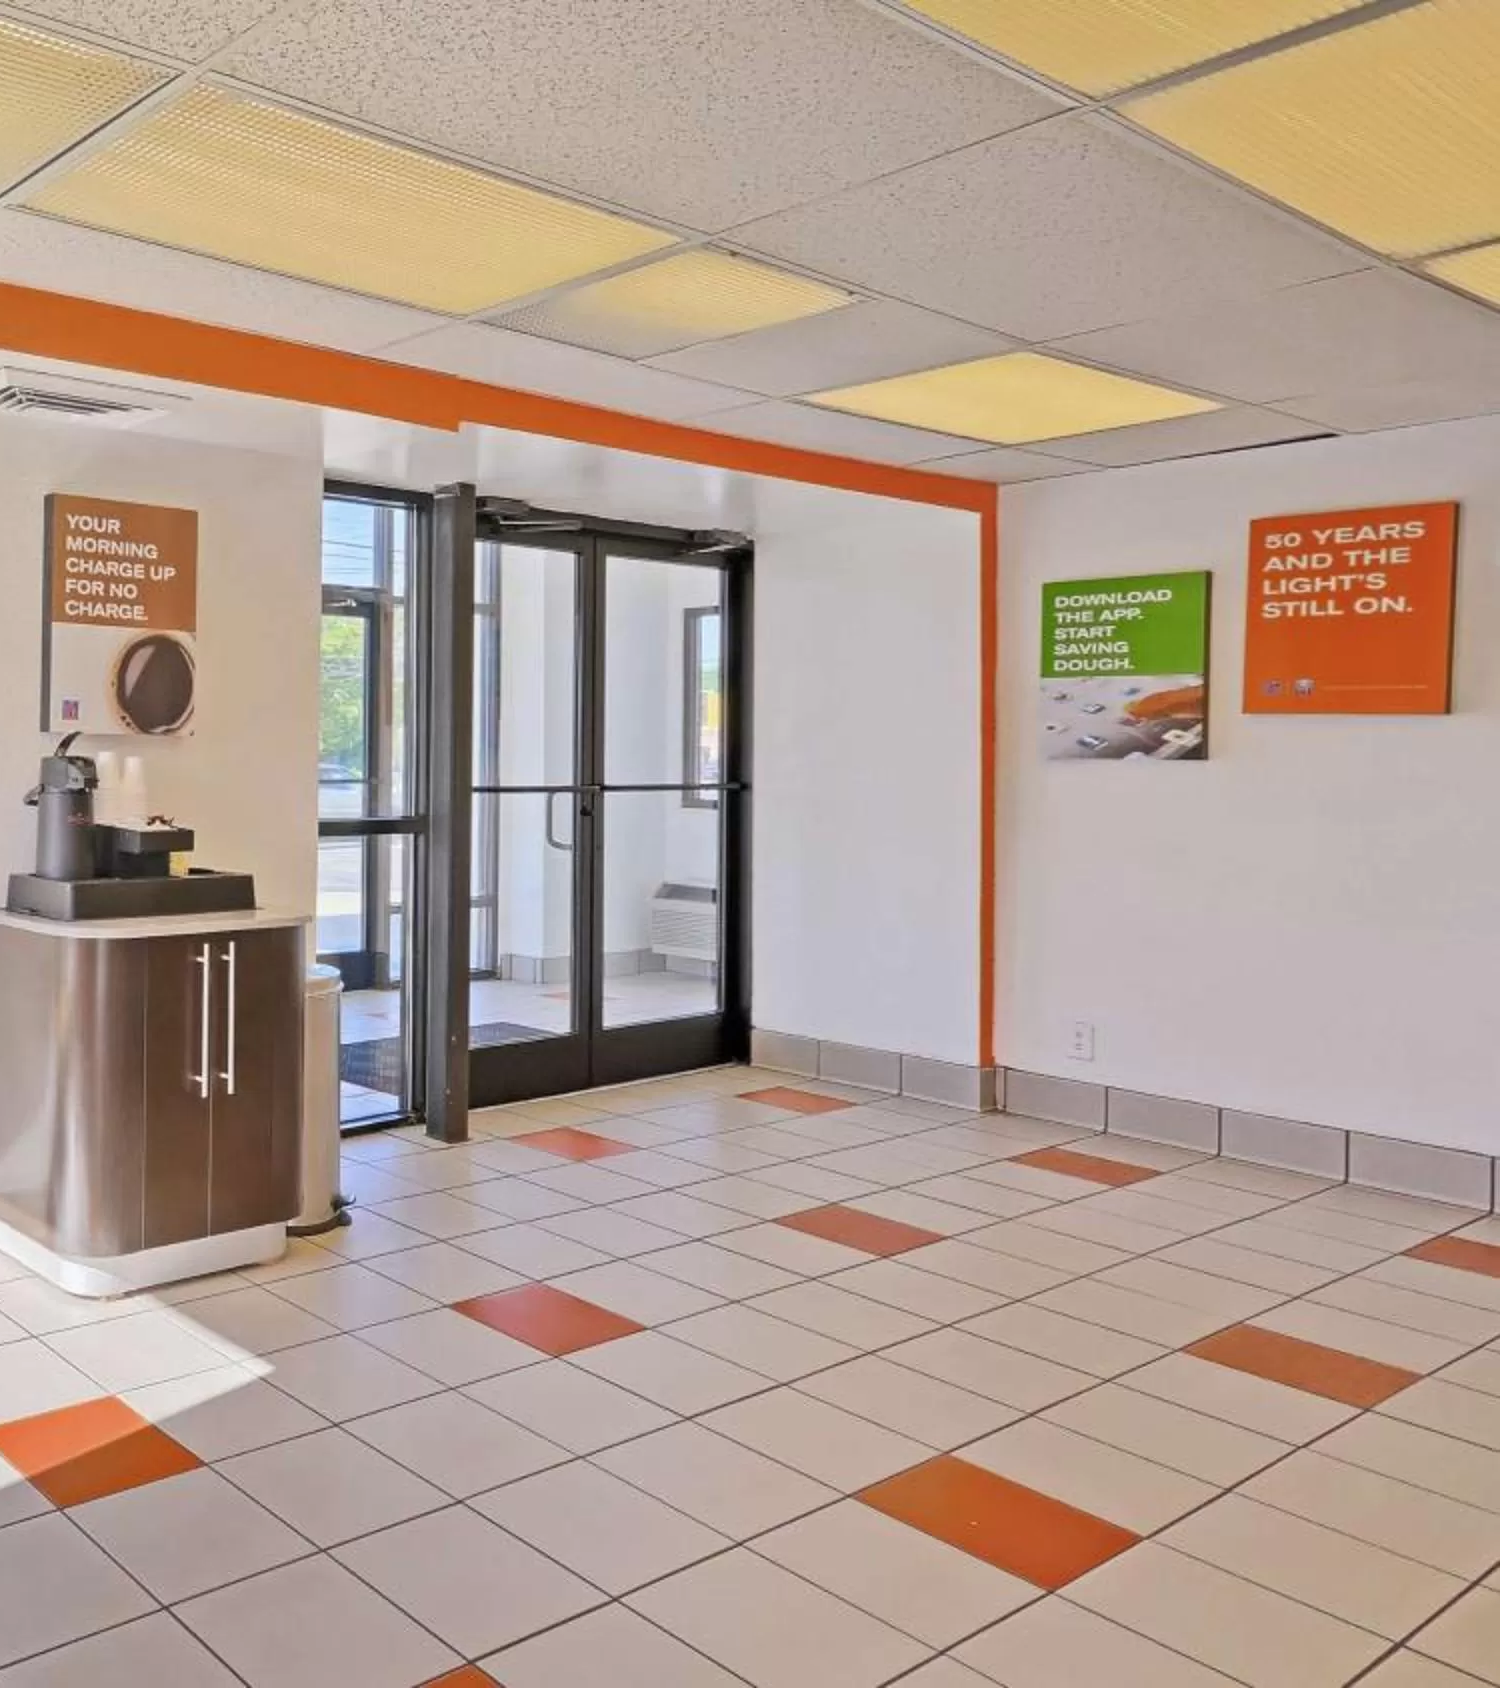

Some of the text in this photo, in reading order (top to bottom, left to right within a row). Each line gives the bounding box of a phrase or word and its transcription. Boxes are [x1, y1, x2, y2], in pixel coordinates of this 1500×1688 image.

[66, 513, 121, 534] YOUR
[1265, 521, 1426, 549] 50 YEARS
[66, 535, 159, 559] MORNING
[65, 557, 177, 581] CHARGE UP
[1262, 546, 1412, 572] AND THE
[65, 577, 138, 599] FOR NO
[1263, 572, 1387, 595] LIGHT'S
[1054, 589, 1173, 608] DOWNLOAD
[1262, 595, 1413, 618] STILL ON.
[65, 600, 148, 621] CHARGE.
[1054, 607, 1145, 624] THE APP.
[1054, 625, 1116, 640] START
[1054, 641, 1129, 655] SAVING
[1054, 658, 1135, 671] DOUGH.
